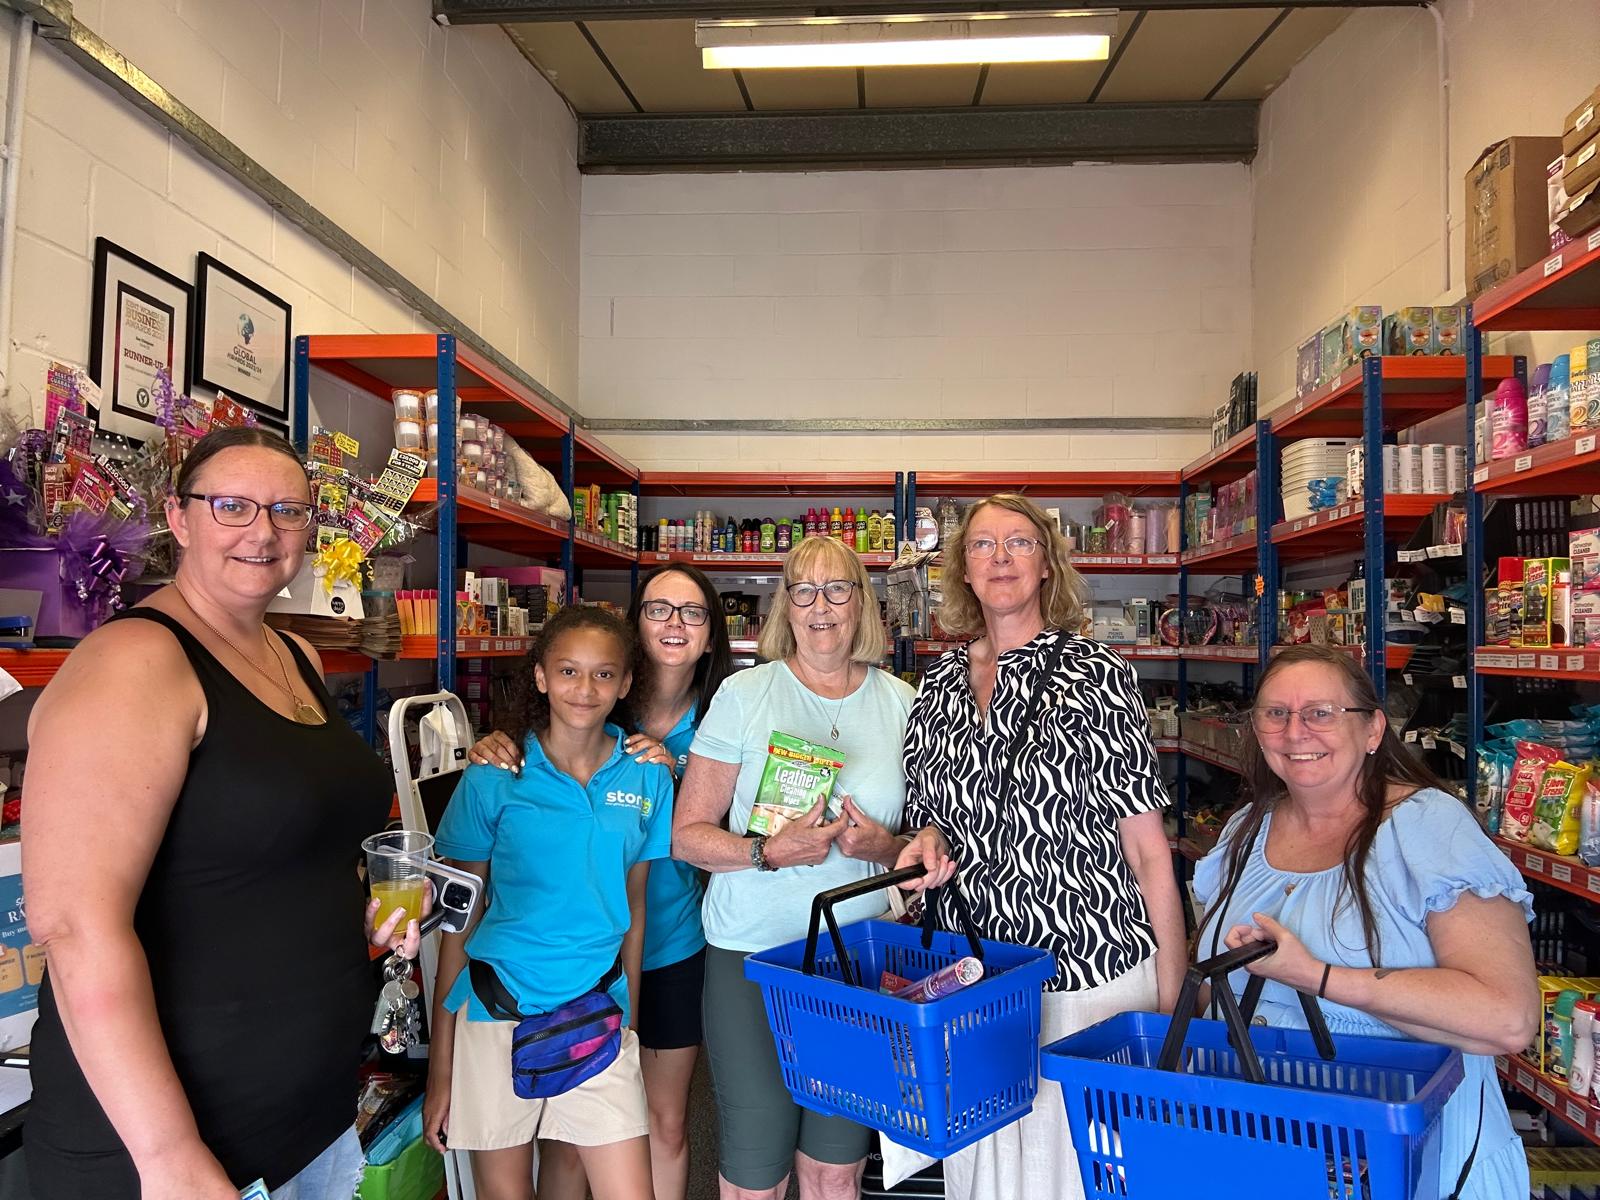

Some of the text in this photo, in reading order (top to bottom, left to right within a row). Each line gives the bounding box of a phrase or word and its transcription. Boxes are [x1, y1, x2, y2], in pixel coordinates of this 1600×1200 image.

[123, 347, 164, 370] RUNNER-UP
[233, 346, 257, 365] GLOBAL
[774, 766, 821, 790] Leather
[780, 784, 807, 799] Cleaning
